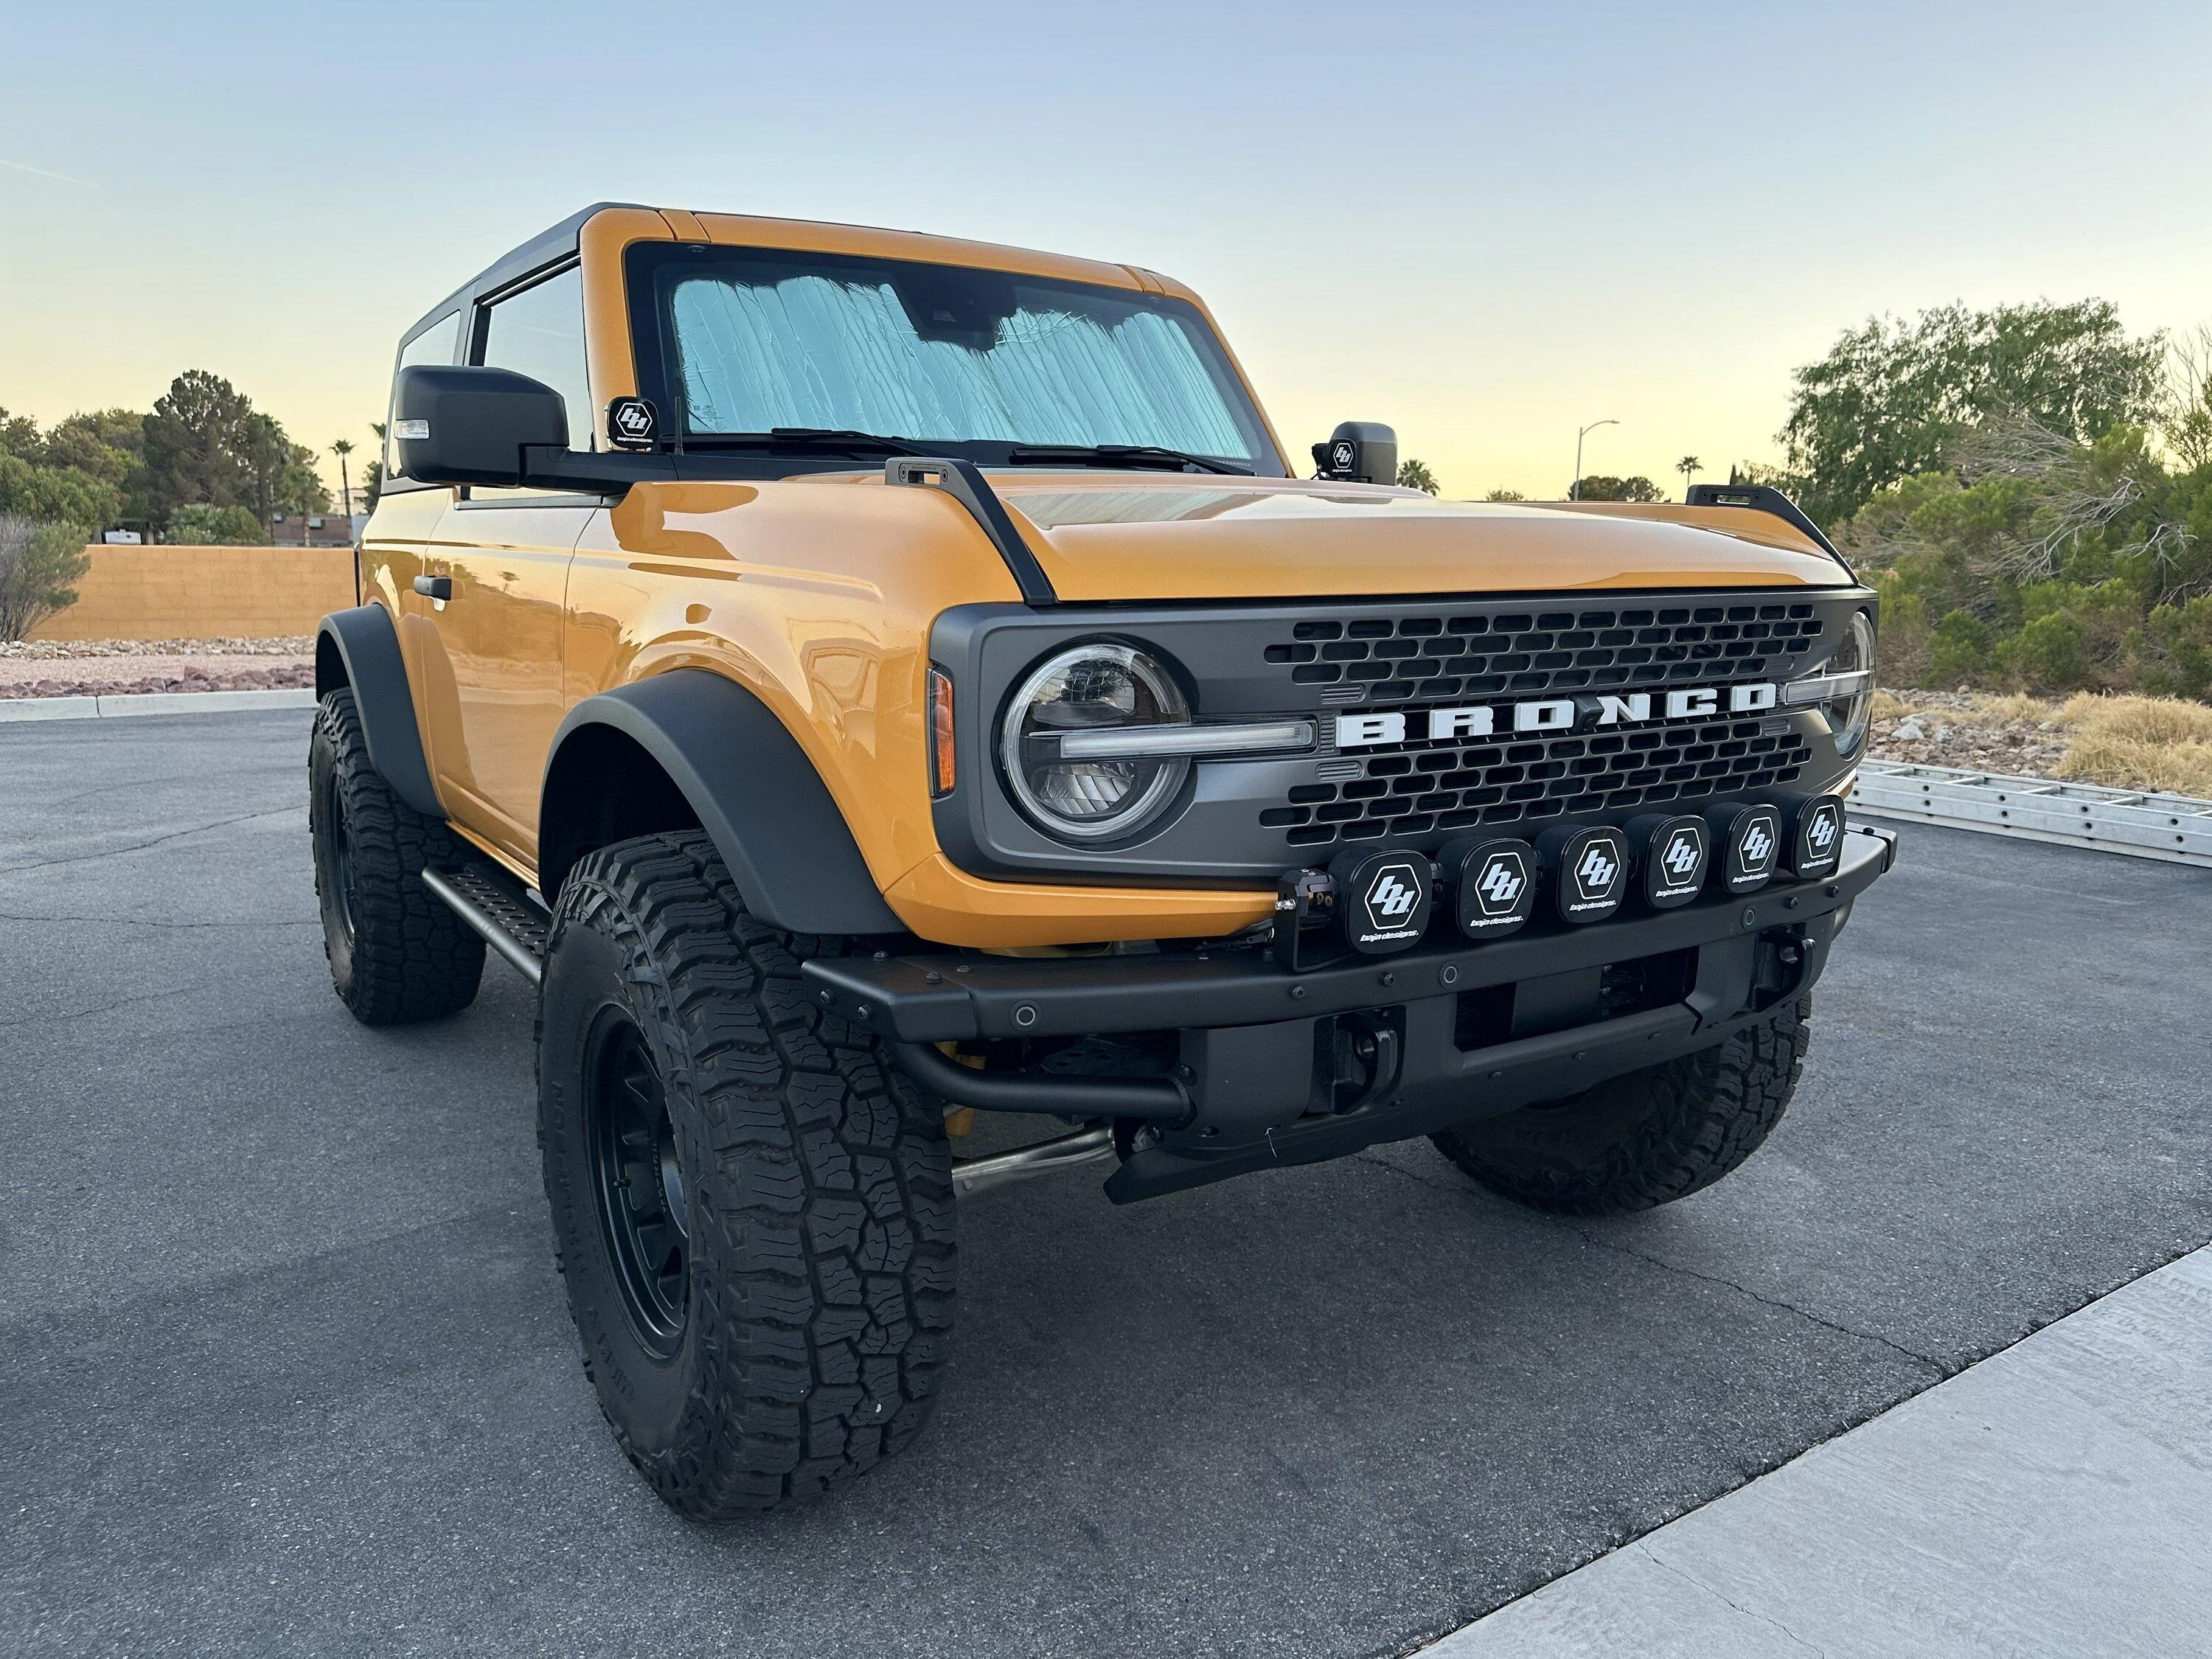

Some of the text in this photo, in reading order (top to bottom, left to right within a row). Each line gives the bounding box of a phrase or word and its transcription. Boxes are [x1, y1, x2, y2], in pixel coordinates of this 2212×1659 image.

[1335, 683, 1777, 748] BRONCO
[1743, 826, 1771, 860] bd
[1810, 814, 1836, 846] bd
[1579, 849, 1615, 886] bd
[1665, 838, 1698, 873] bd
[1371, 875, 1416, 915] bd
[1481, 863, 1522, 902] bd
